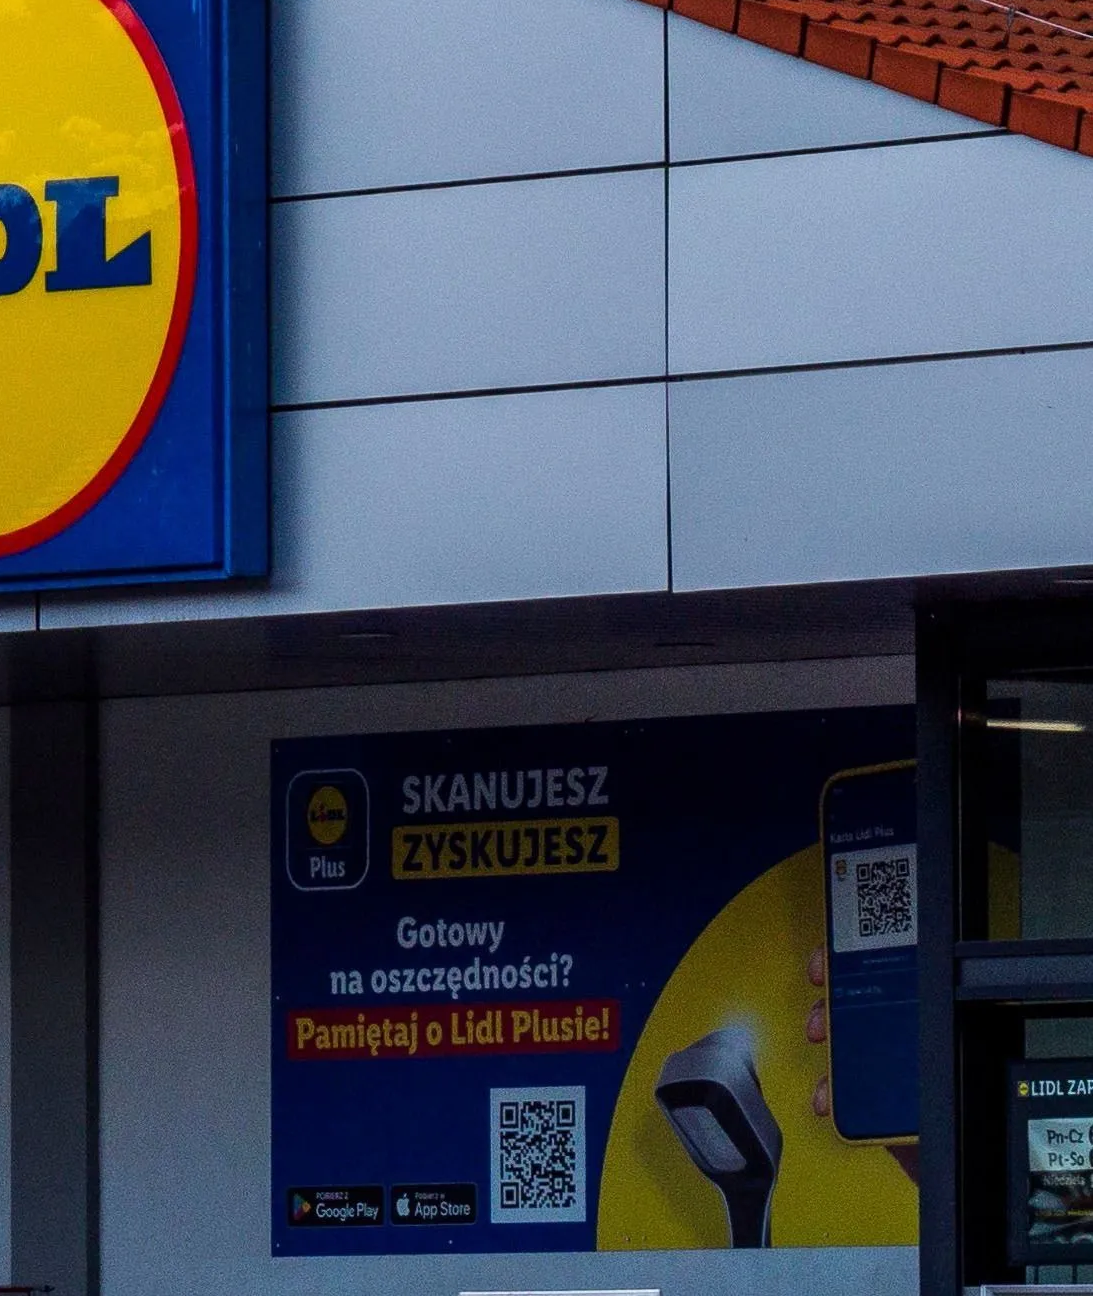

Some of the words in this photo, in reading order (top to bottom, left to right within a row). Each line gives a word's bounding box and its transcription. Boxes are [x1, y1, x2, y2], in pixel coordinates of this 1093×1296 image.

[402, 766, 609, 815] SKANUJESZ
[402, 826, 608, 871] ZYSKUJESZ
[309, 856, 346, 879] Plus
[396, 916, 505, 953] Gotowy
[329, 969, 363, 994] na
[370, 952, 574, 1000] oszczędności?
[295, 1012, 418, 1056] Pamiętaj
[426, 1021, 443, 1046] o
[450, 1010, 503, 1046] Lidl
[510, 1006, 611, 1044] Plusie!
[1031, 1080, 1064, 1097] LIDL
[1047, 1129, 1084, 1144] Pn-Cz
[1048, 1151, 1085, 1166] Pt-So
[316, 1202, 355, 1221] Google
[356, 1202, 379, 1220] Play
[414, 1202, 438, 1220] App
[440, 1201, 471, 1216] Store
